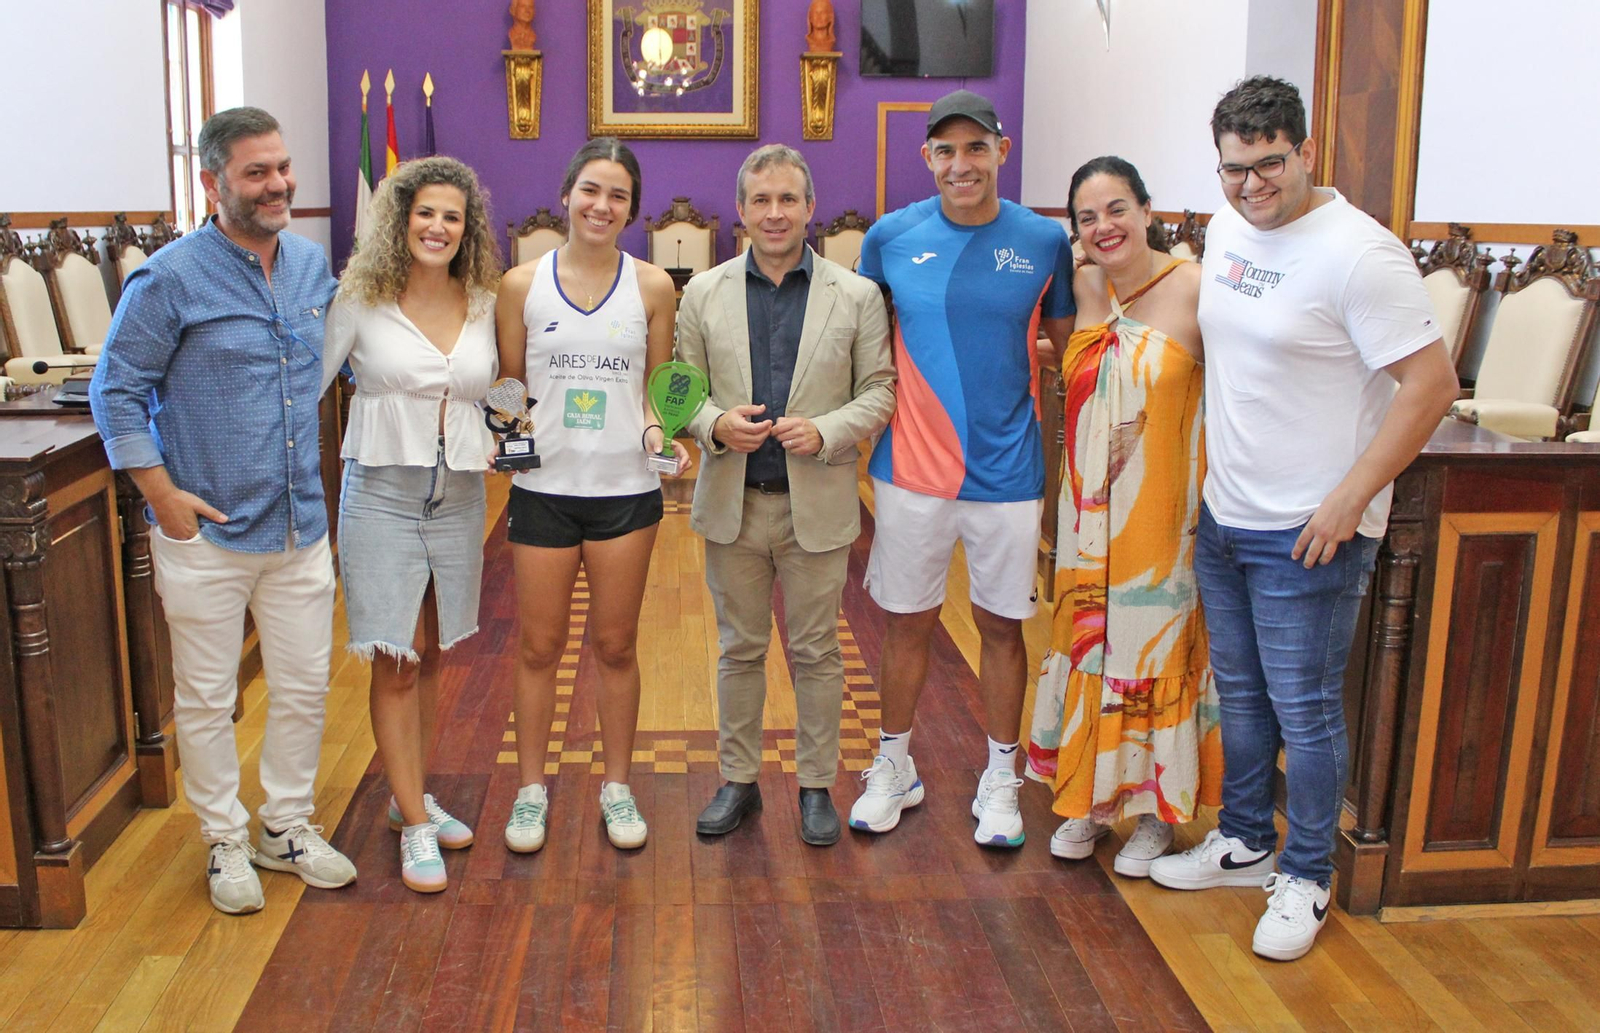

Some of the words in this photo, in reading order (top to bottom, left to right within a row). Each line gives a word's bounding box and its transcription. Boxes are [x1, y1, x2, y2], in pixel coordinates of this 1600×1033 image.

[1009, 261, 1034, 270] Iglesias
[1240, 259, 1286, 289] Tommy
[1233, 276, 1265, 299] Jeans
[549, 354, 586, 368] AIRES
[594, 355, 630, 371] JAÉN
[595, 375, 614, 383] Virgen
[665, 395, 685, 406] FAP
